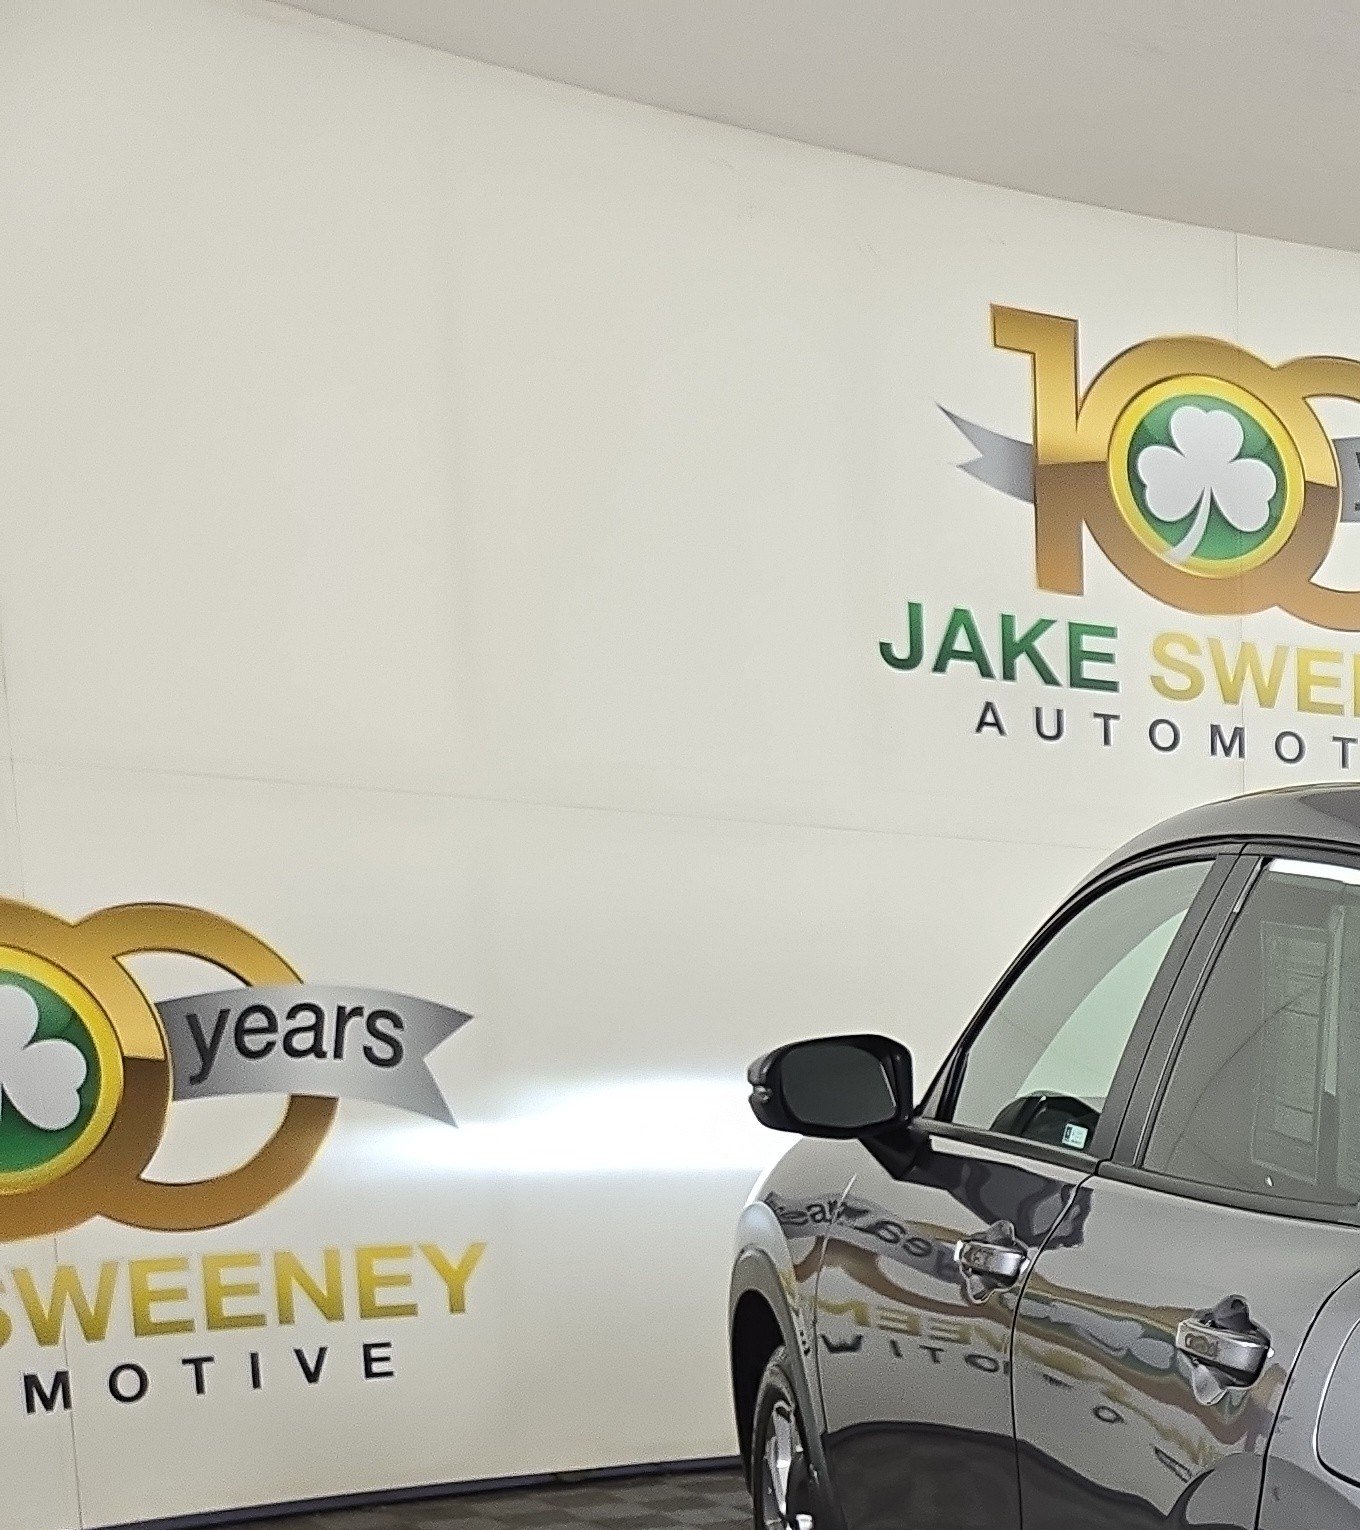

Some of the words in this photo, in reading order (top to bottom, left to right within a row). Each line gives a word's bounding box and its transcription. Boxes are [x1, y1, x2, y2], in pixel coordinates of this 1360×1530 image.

[878, 602, 1121, 694] JAKE
[185, 1001, 405, 1085] years
[0, 1241, 488, 1348] WEENEY
